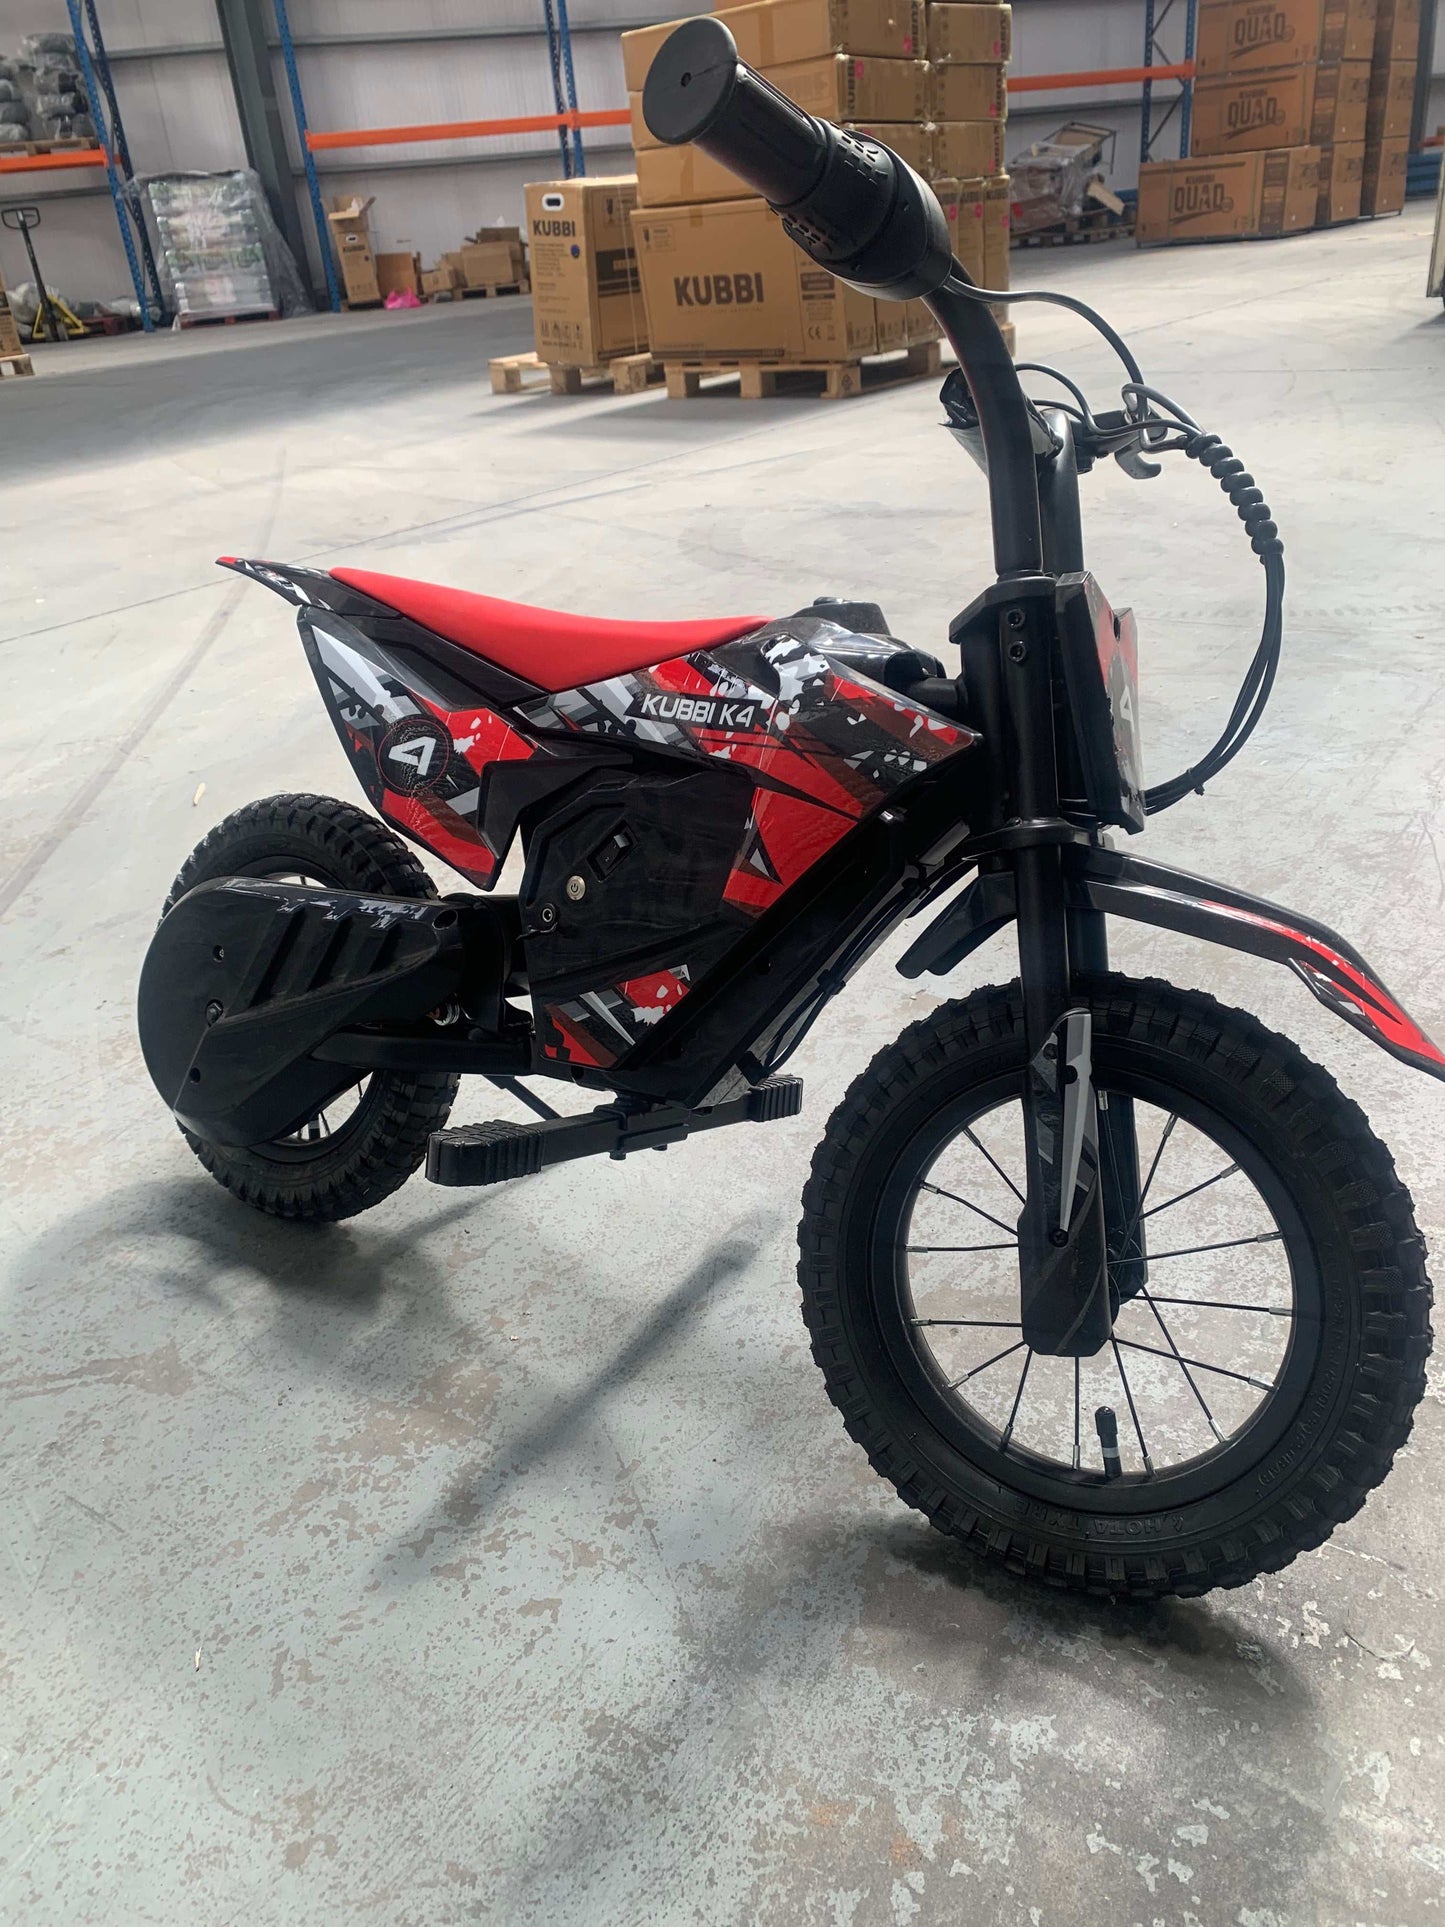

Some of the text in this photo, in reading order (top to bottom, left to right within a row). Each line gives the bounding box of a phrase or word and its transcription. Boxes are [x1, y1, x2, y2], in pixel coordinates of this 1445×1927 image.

[1235, 12, 1286, 46] QUAD
[1228, 97, 1277, 129] QUAD
[1175, 183, 1224, 213] QUAD
[532, 220, 576, 237] KUBBI
[674, 272, 764, 307] KUBBI
[641, 693, 755, 728] KUBBI K4
[388, 736, 437, 776] 4
